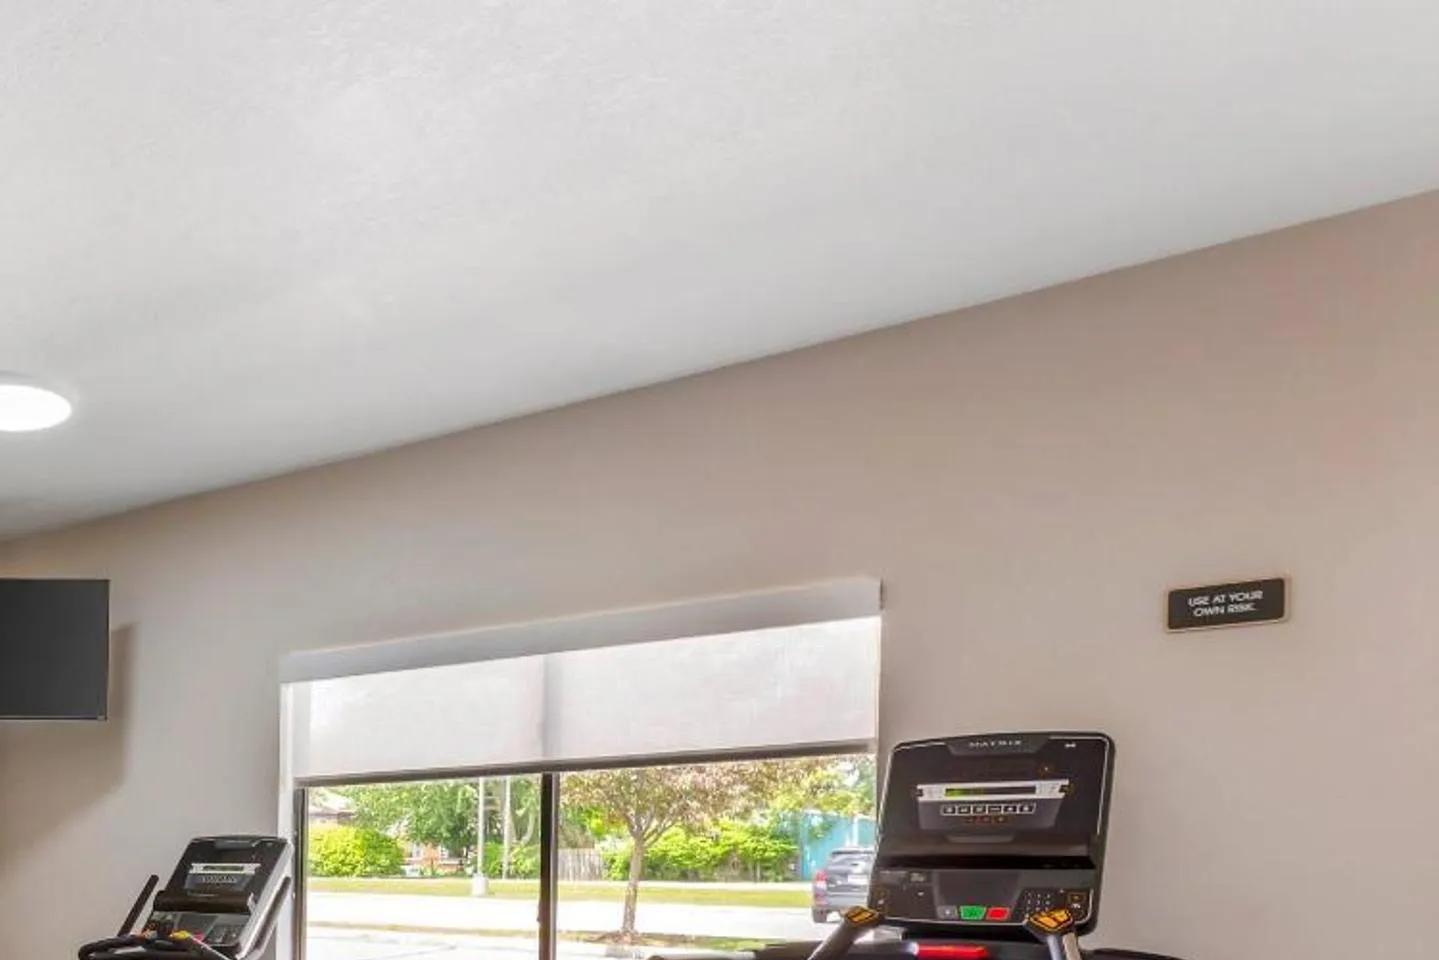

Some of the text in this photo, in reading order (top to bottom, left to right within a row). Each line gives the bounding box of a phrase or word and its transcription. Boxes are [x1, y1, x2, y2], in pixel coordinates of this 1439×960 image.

[1188, 590, 1263, 607] USE AT YOUR
[1193, 605, 1224, 617] OWN
